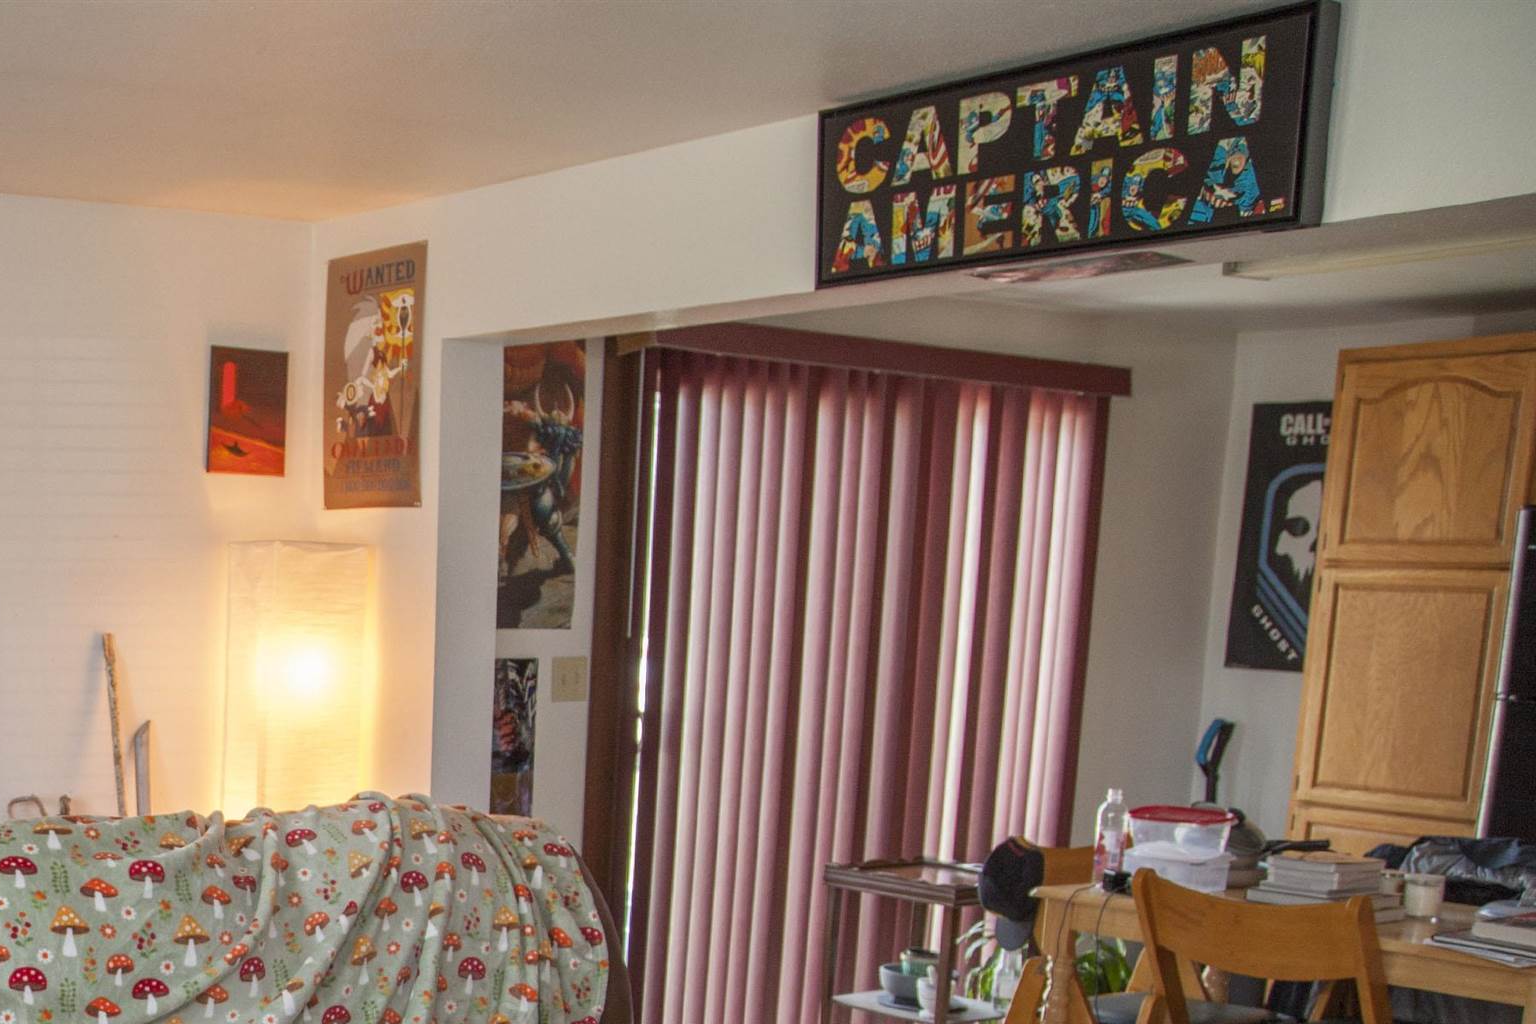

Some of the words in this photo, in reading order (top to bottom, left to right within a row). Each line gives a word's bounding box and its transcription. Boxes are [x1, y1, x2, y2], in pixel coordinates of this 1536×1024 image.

[836, 34, 1267, 194] CAPTAIN
[830, 136, 1266, 273] AMERICA
[345, 257, 416, 296] WANTED
[1279, 412, 1325, 437] CALL
[1285, 435, 1329, 447] GHO
